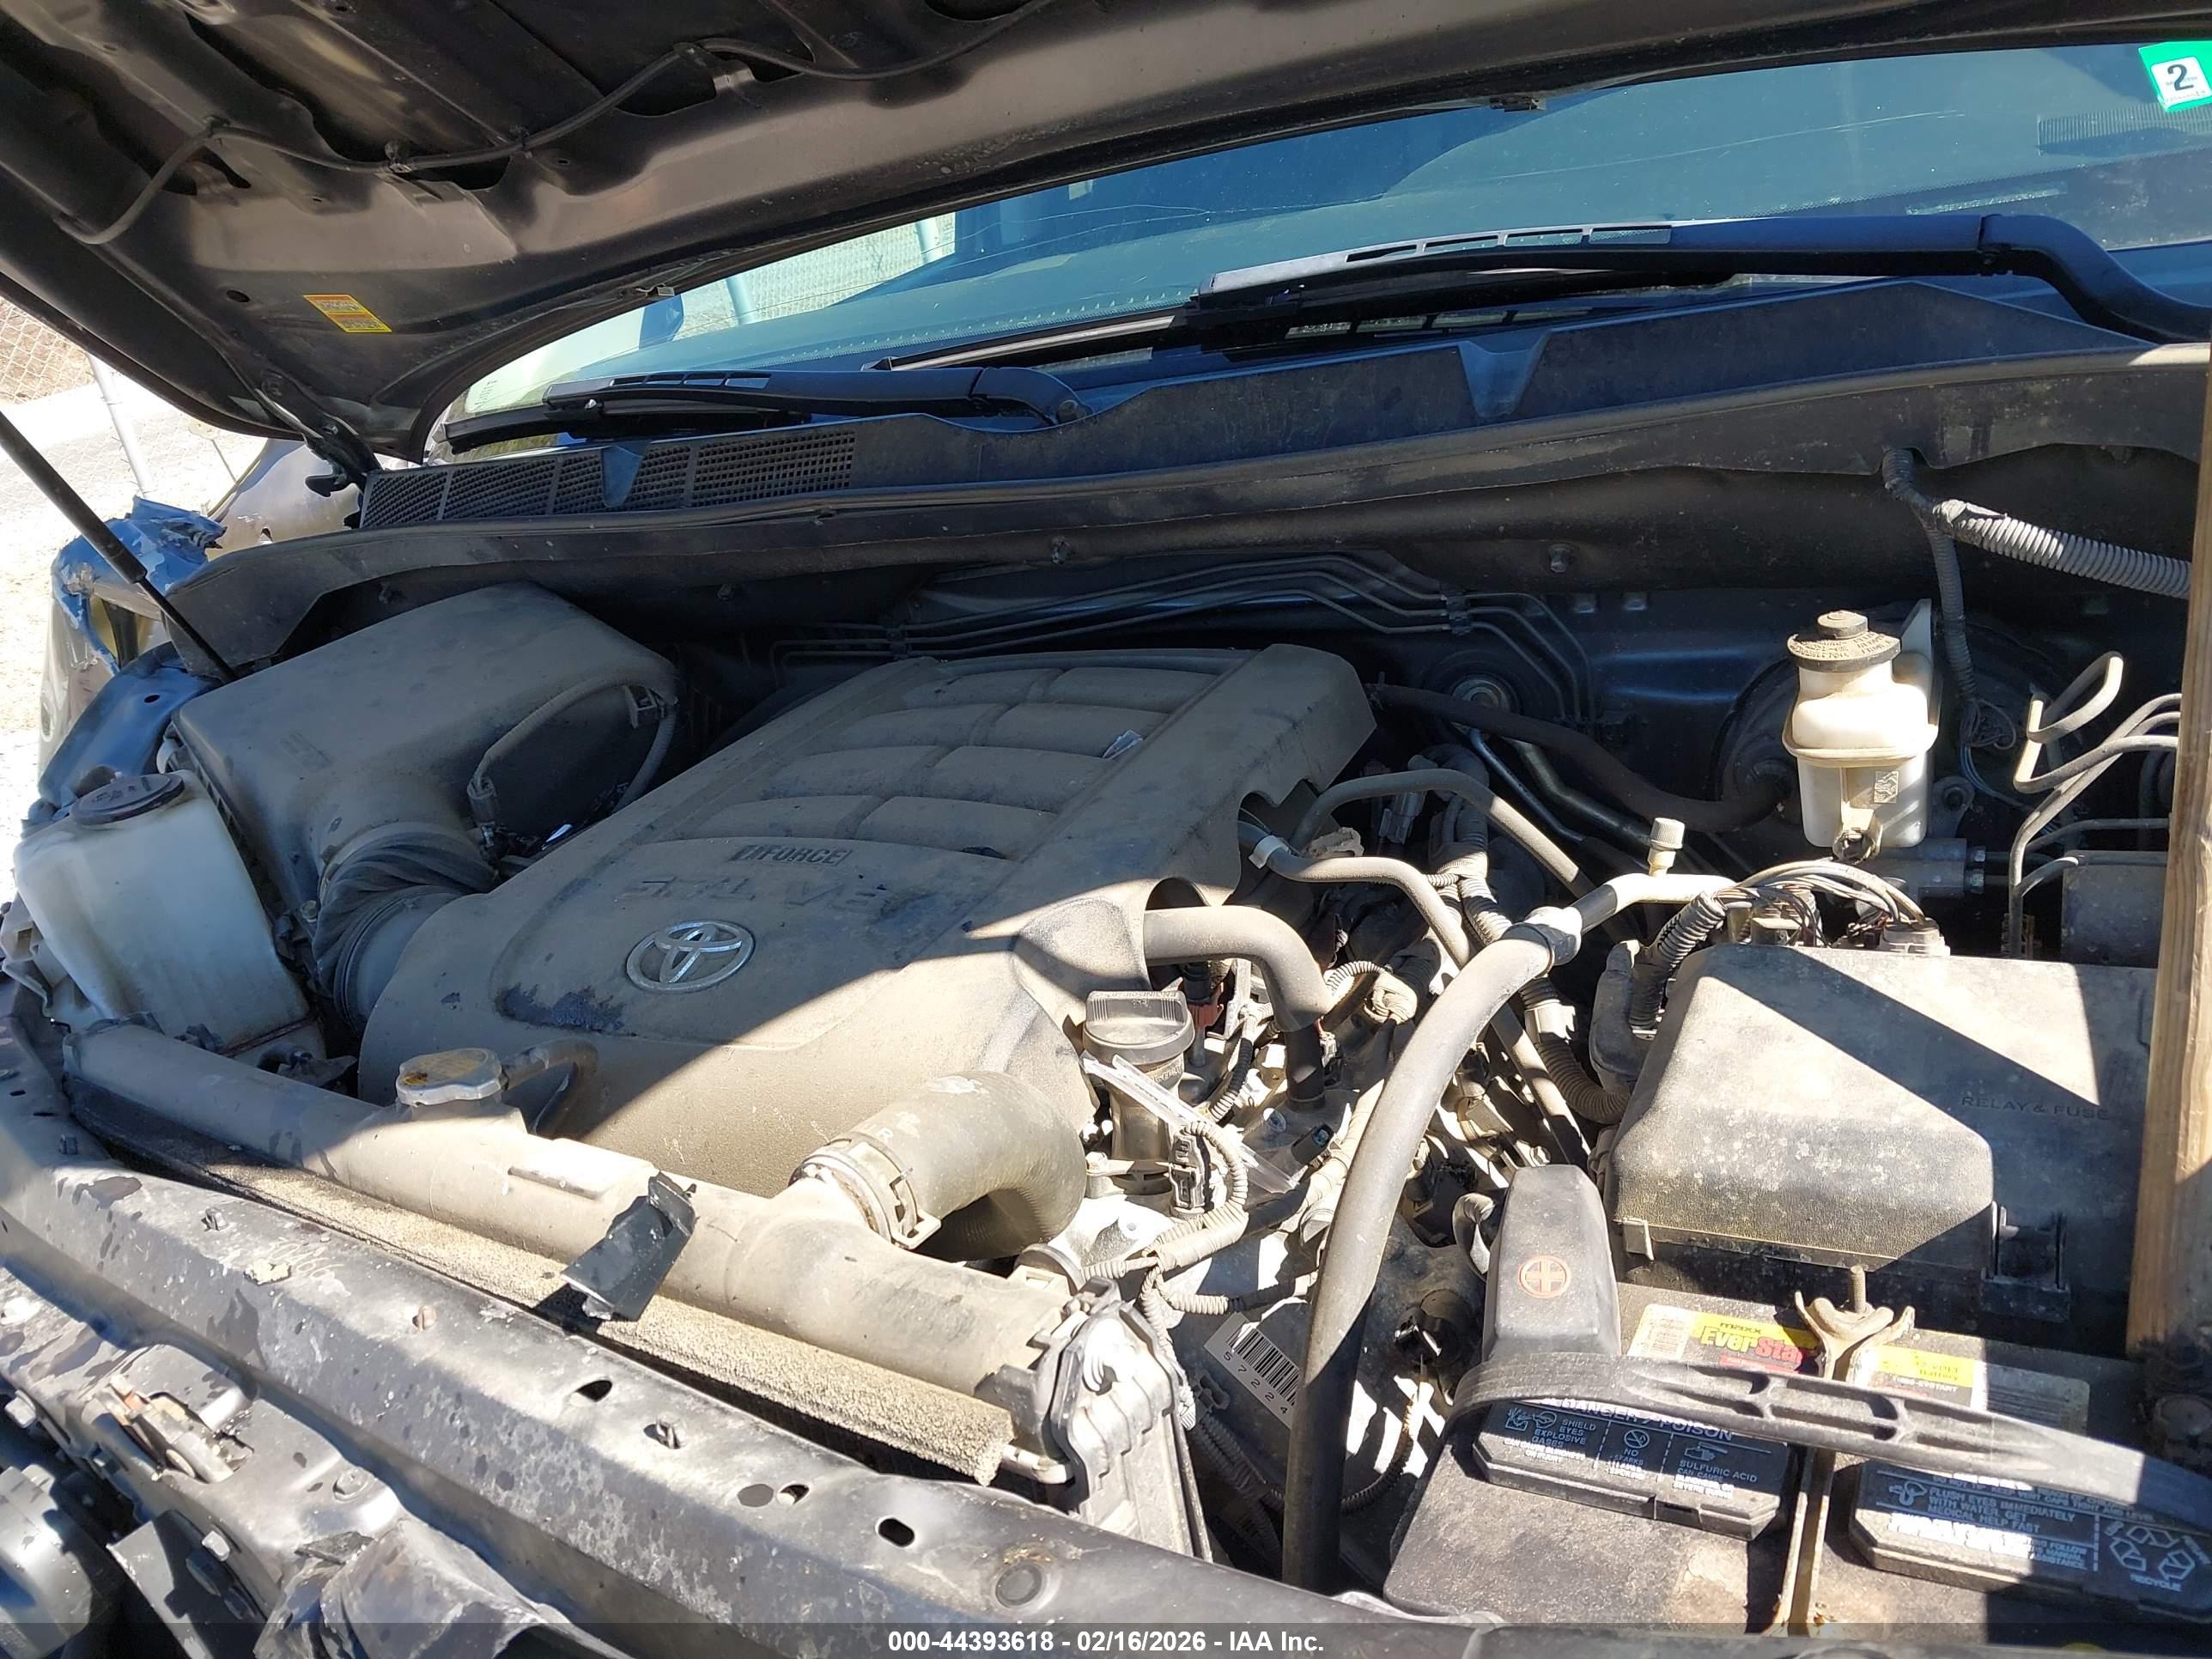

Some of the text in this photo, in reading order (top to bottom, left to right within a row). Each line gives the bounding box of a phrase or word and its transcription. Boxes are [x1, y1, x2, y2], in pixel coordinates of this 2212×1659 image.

[2167, 64, 2195, 91] 2
[1961, 1096, 2110, 1121] RELAY & FUSE
[1559, 1426, 1584, 1437] EYES
[1561, 1419, 1596, 1431] SHIELD
[1531, 1436, 1565, 1448] GASES
[1534, 1428, 1587, 1445] EXPLOSIVE
[1624, 1448, 1639, 1457] NO
[1679, 1459, 1758, 1482] SULFURIC ACID
[1929, 1487, 1966, 1502] FLUSH
[1968, 1494, 1997, 1508] EYES
[2000, 1499, 2075, 1522] IMMEDIATELY
[1929, 1496, 1958, 1510] WITH
[2004, 1510, 2027, 1522] GET
[1927, 1505, 2041, 1534] MEDICAL HELP FAST
[2130, 1573, 2182, 1593] RECYCLE
